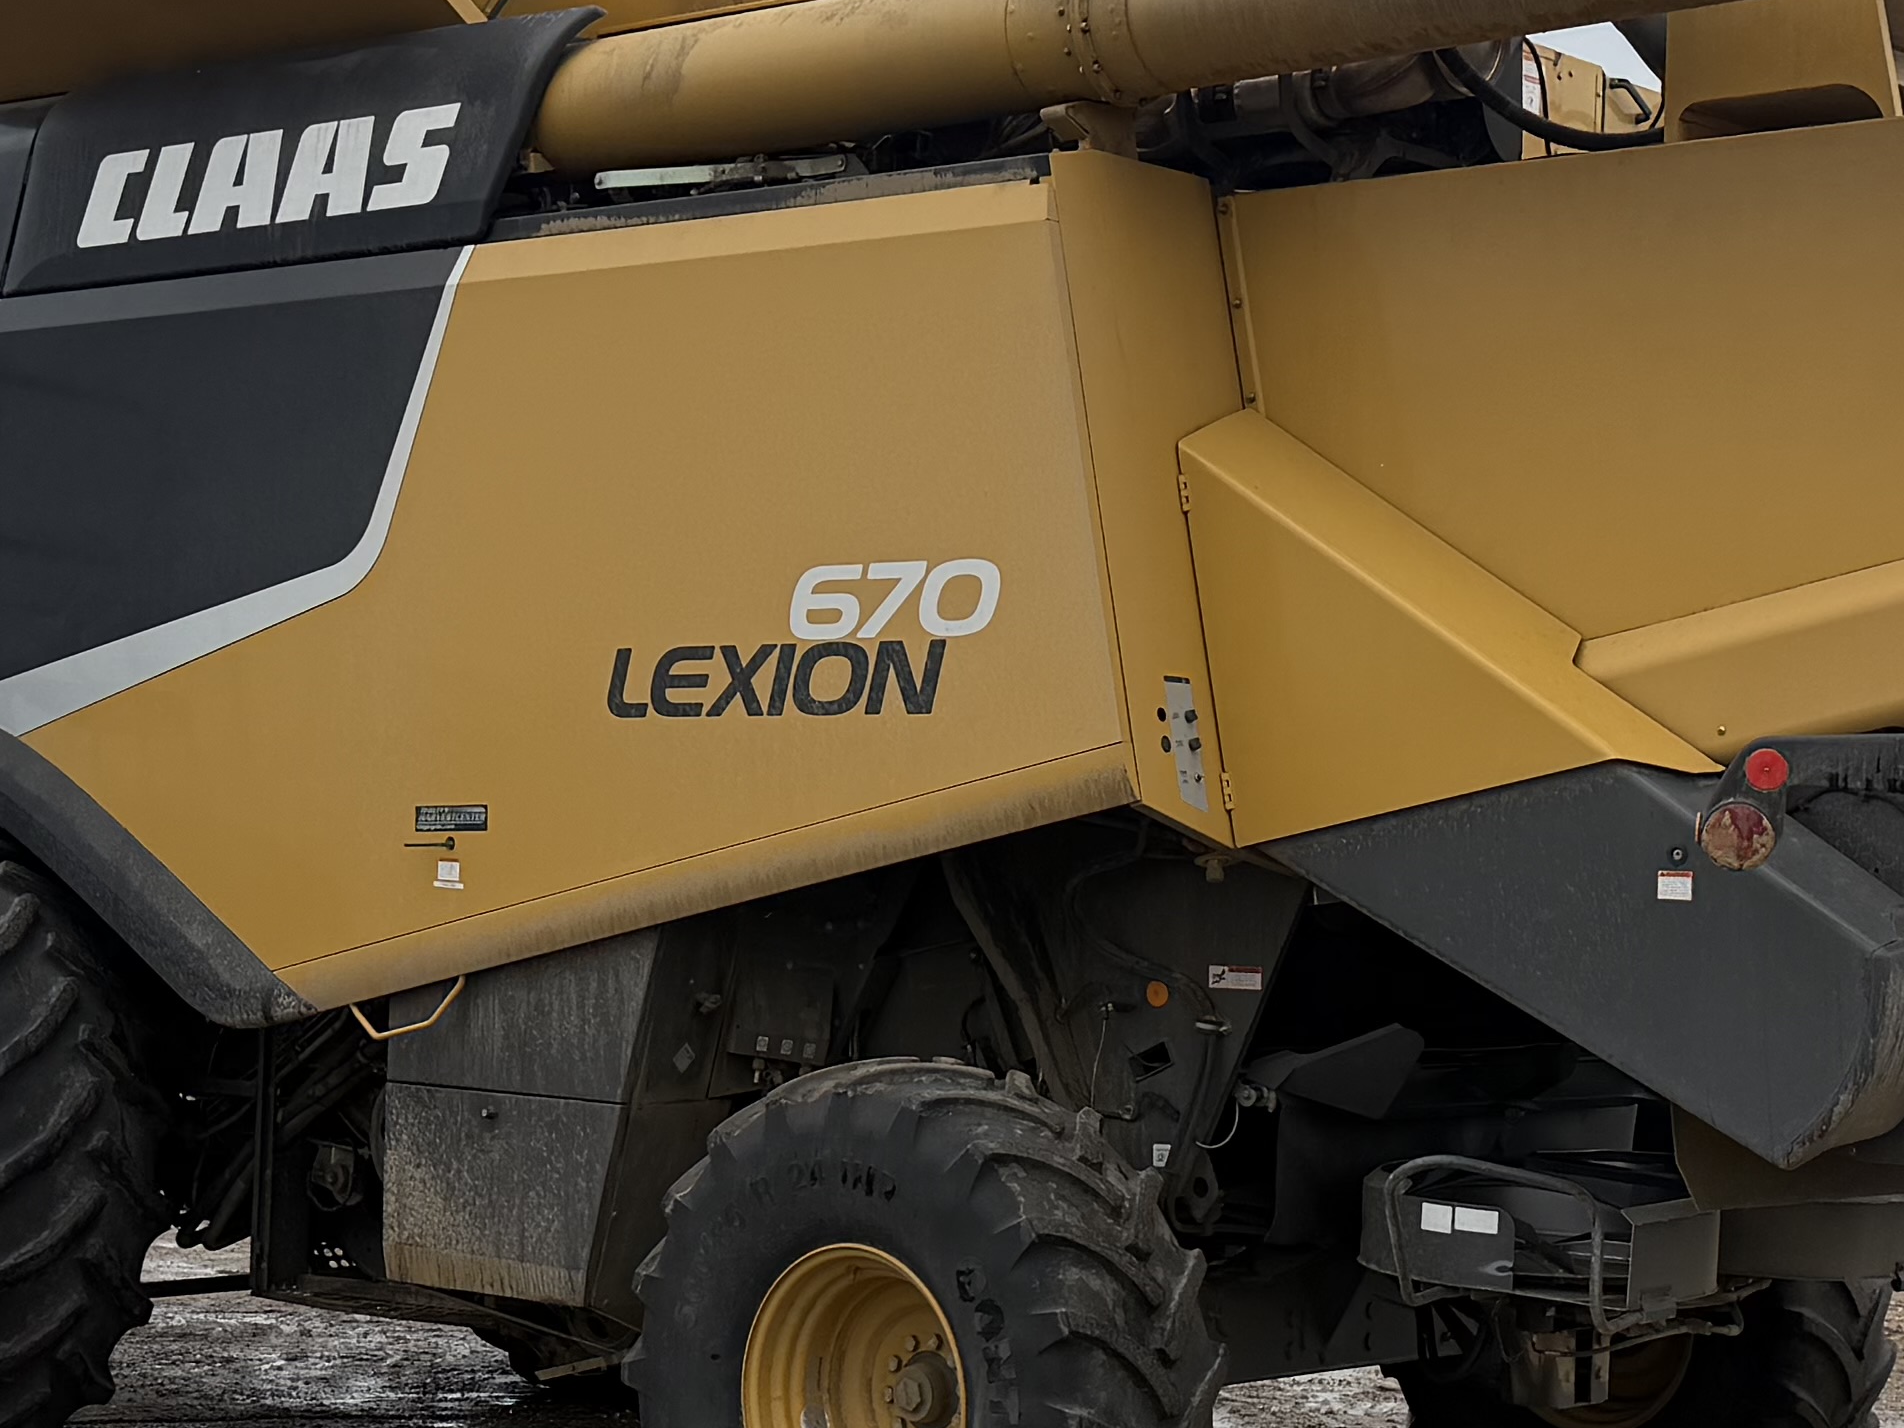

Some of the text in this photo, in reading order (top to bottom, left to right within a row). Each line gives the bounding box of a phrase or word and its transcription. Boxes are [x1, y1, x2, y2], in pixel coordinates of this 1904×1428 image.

[77, 103, 461, 248] CLAAS
[789, 558, 1001, 640] 670
[606, 639, 947, 718] LEXION
